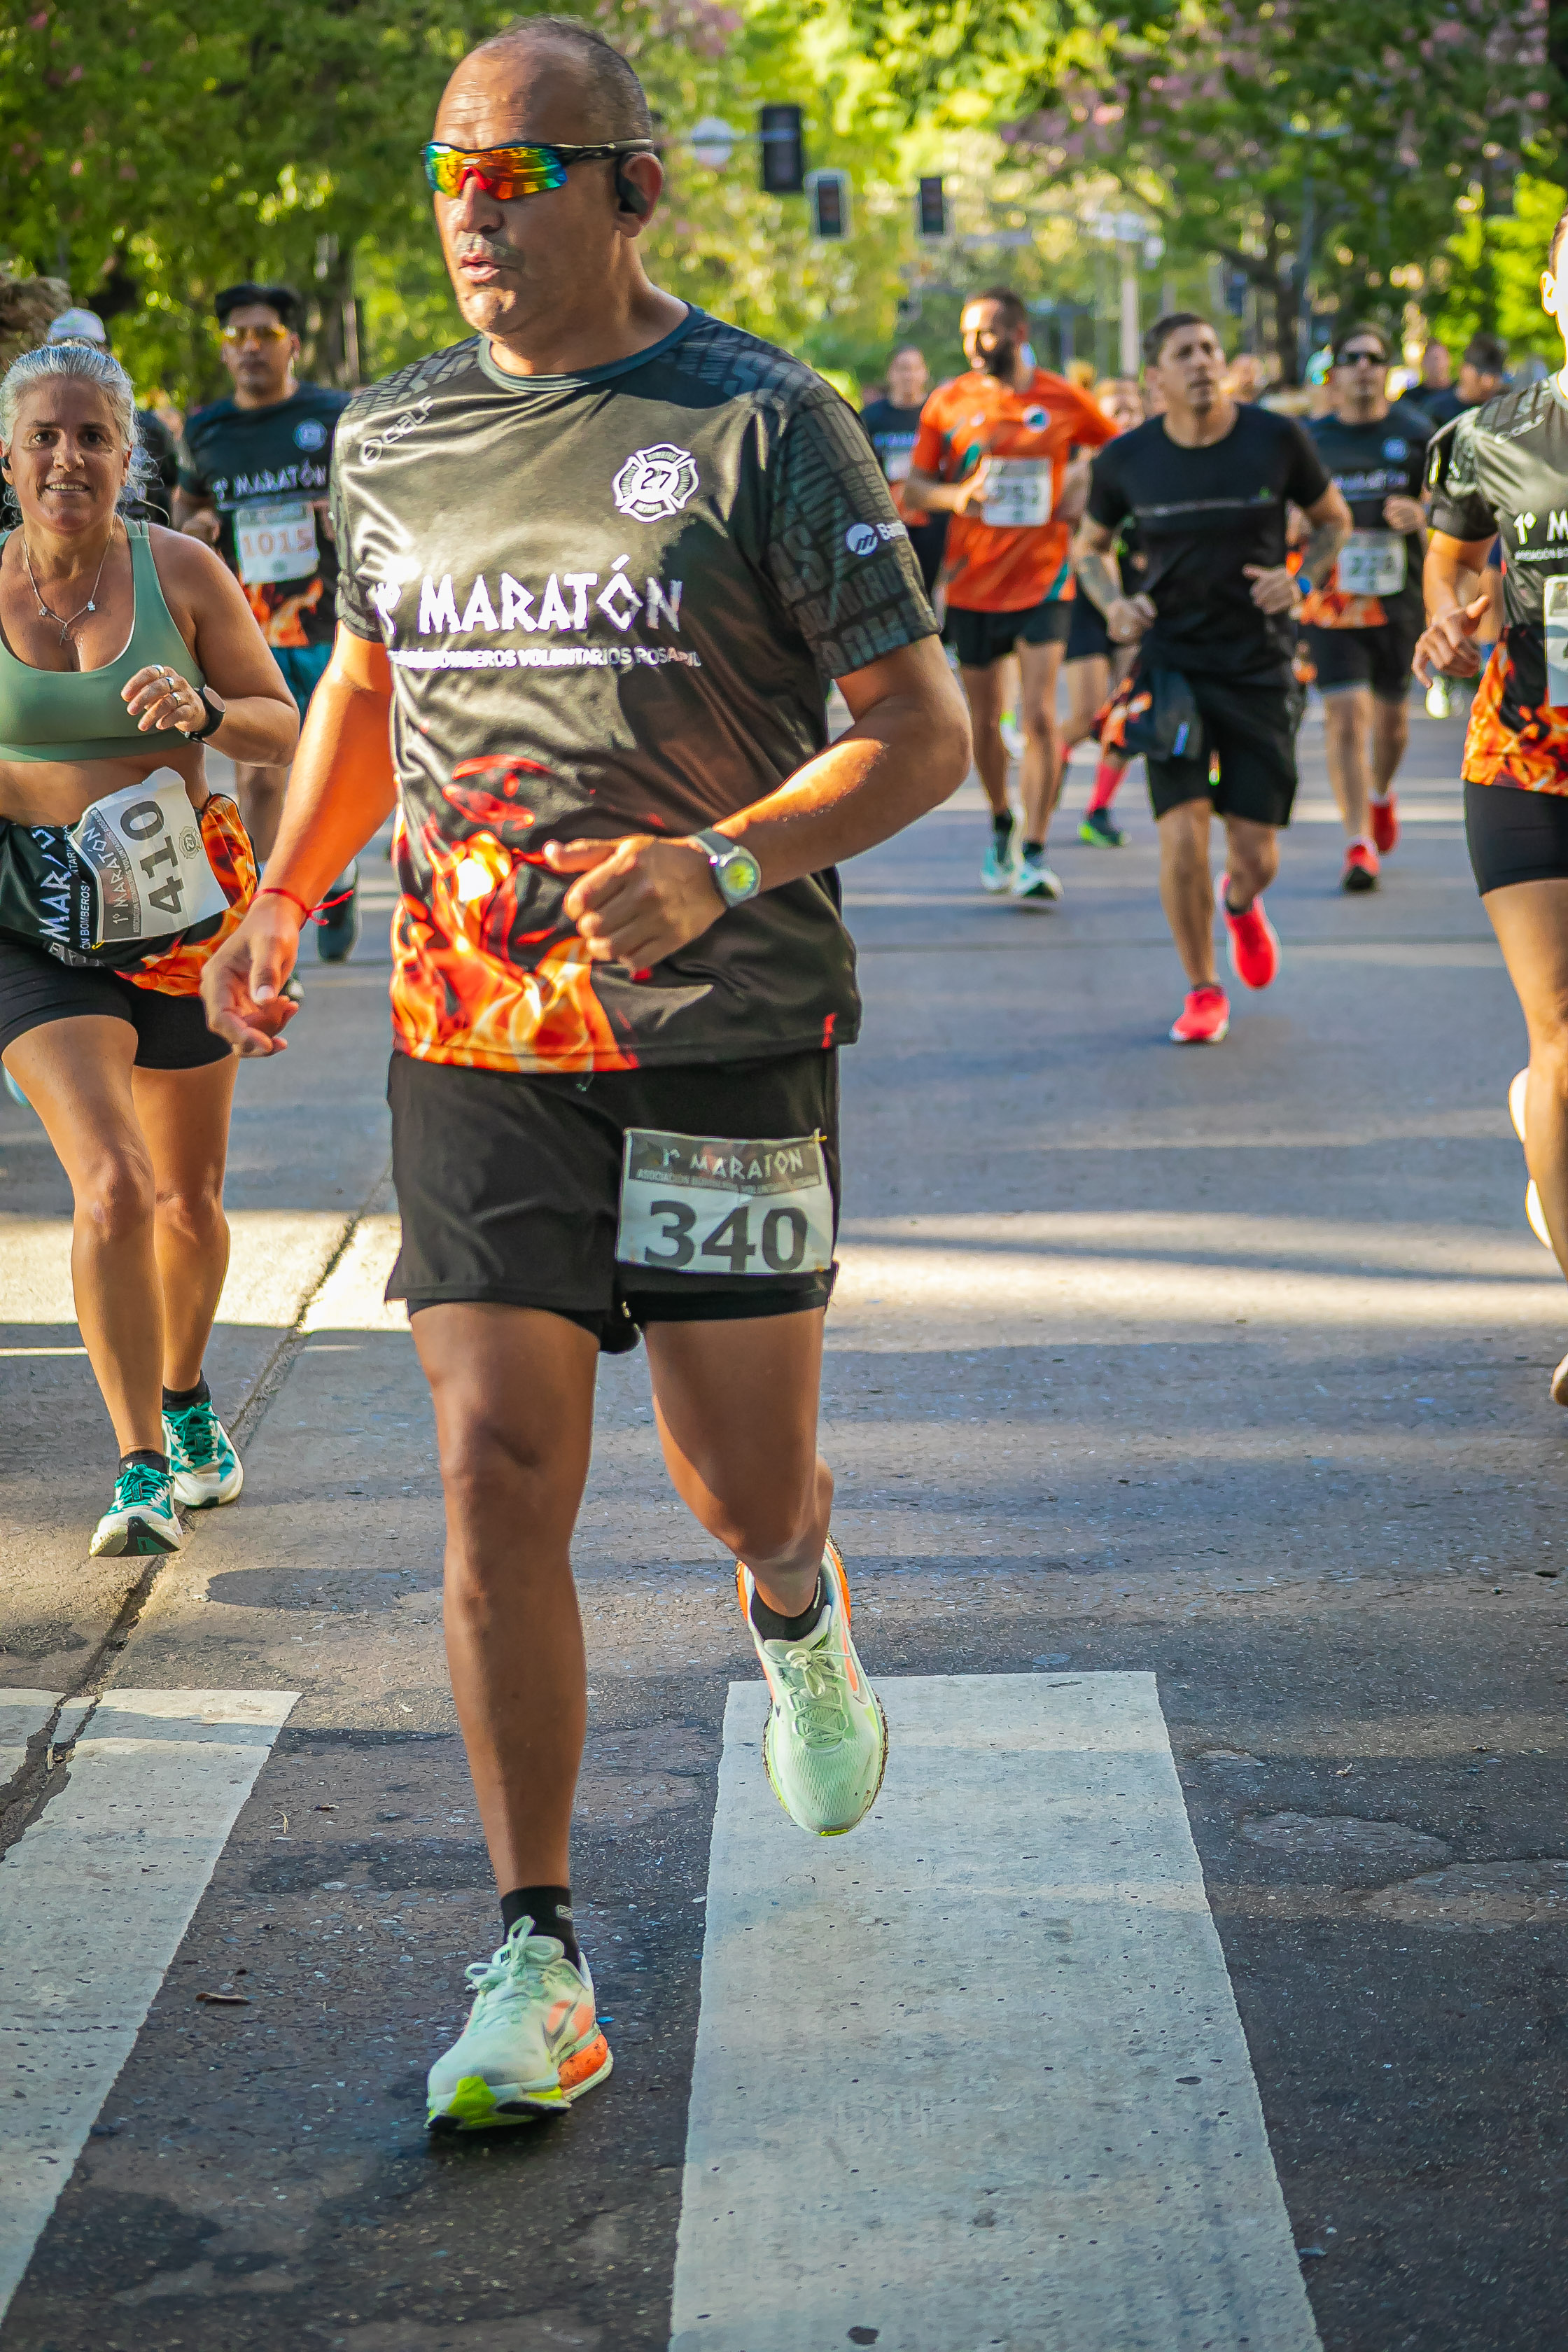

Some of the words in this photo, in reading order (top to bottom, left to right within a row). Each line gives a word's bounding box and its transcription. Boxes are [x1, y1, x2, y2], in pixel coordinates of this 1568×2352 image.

[640, 467, 672, 490] 27
[242, 528, 314, 557] 1015
[418, 553, 684, 635] MARATÓN
[90, 809, 110, 833] ROSARIO
[82, 827, 130, 909] MARATÓN
[106, 832, 131, 870] VOLUNTARIOS
[120, 800, 185, 915] 410
[80, 884, 90, 937] BOMBEROS
[645, 1200, 808, 1273] 340
